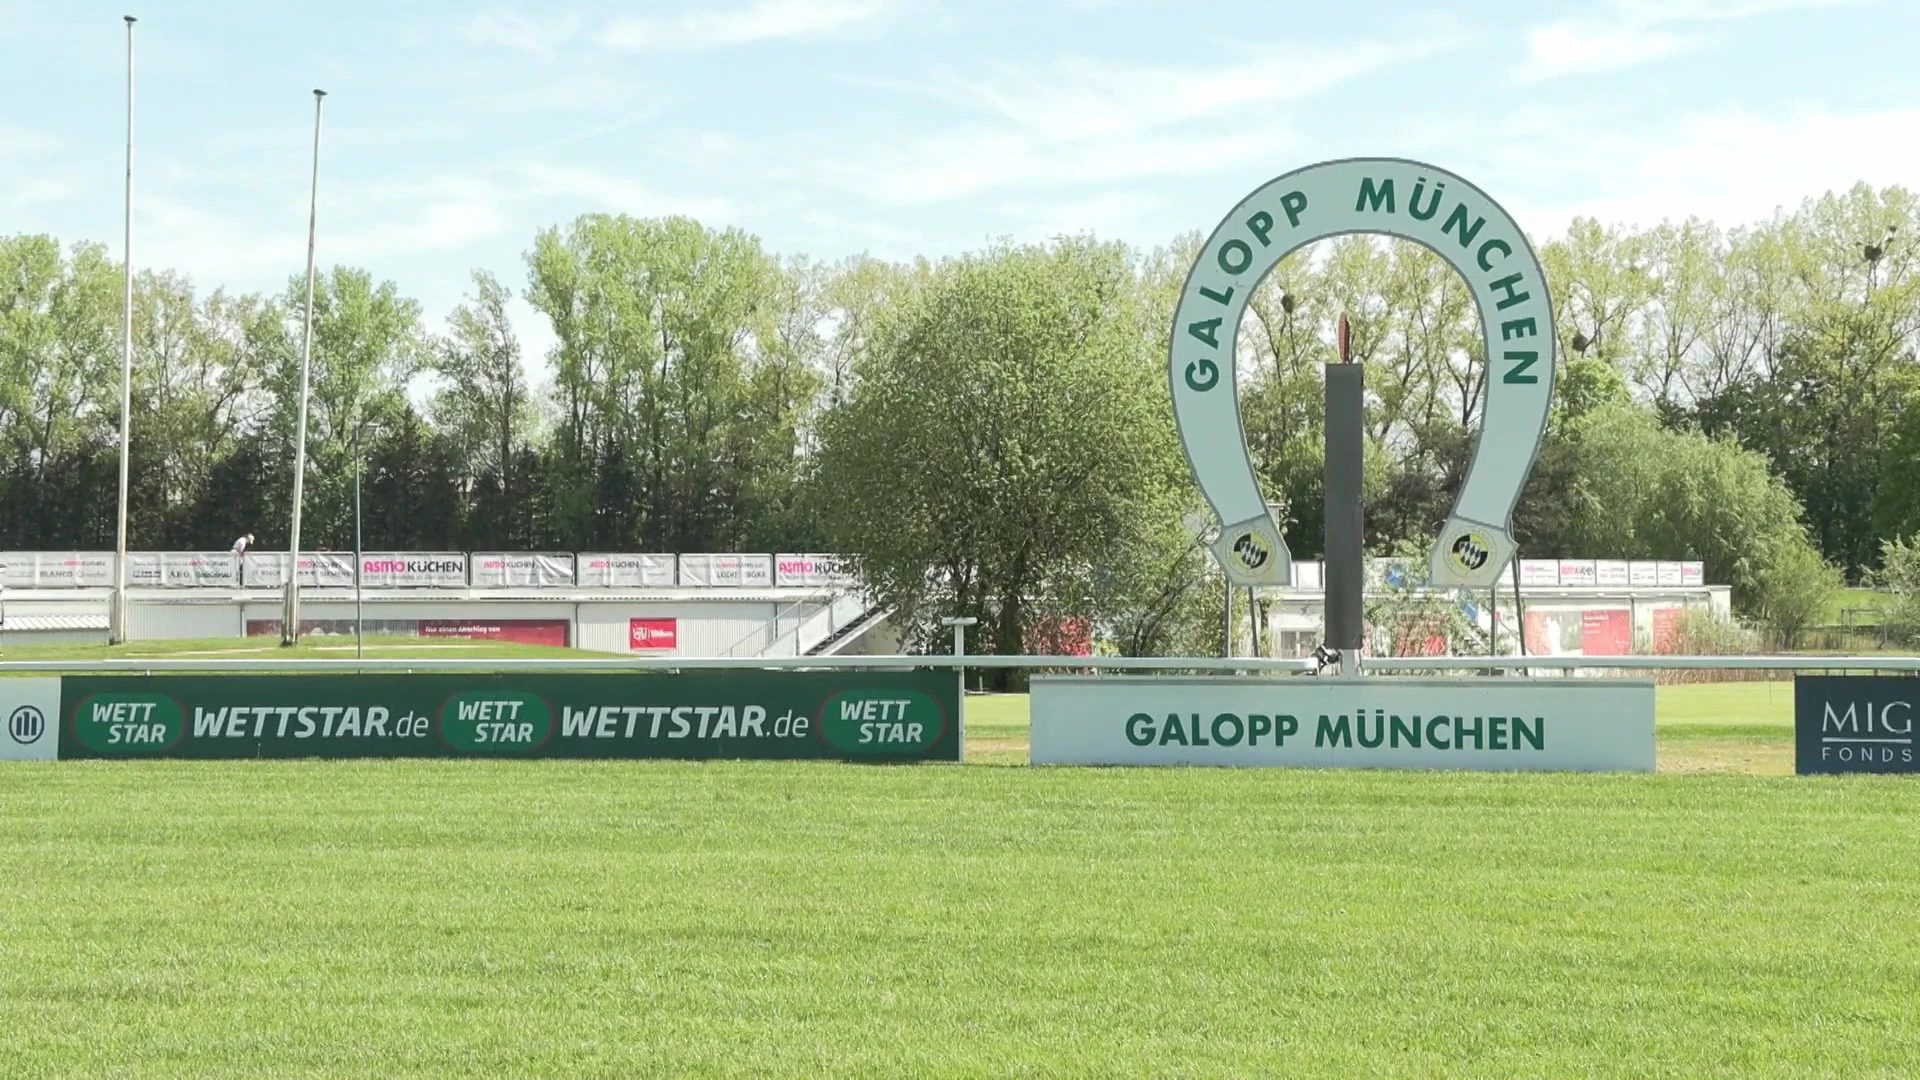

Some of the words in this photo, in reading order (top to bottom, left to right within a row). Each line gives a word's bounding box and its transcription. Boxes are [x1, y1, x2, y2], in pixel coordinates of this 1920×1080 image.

[1185, 190, 1308, 393] GALOPP
[1355, 176, 1538, 385] MÜNCHEN
[363, 561, 405, 573] ASMO
[407, 561, 463, 573] KÜCHEN
[779, 561, 813, 574] ASMO
[92, 702, 157, 723] WETT
[458, 700, 524, 721] WETT
[840, 699, 911, 721] WETT
[1821, 700, 1913, 734] MIG
[193, 706, 429, 739] WETTSTAR.de
[474, 722, 534, 743] STAR
[562, 705, 809, 739] WETTSTAR.de
[858, 722, 923, 743] STAR
[1125, 712, 1299, 747] GALOPP
[1314, 708, 1545, 751] MÜNCHEN
[107, 723, 167, 744] STAR
[1821, 746, 1913, 762] FONDS
